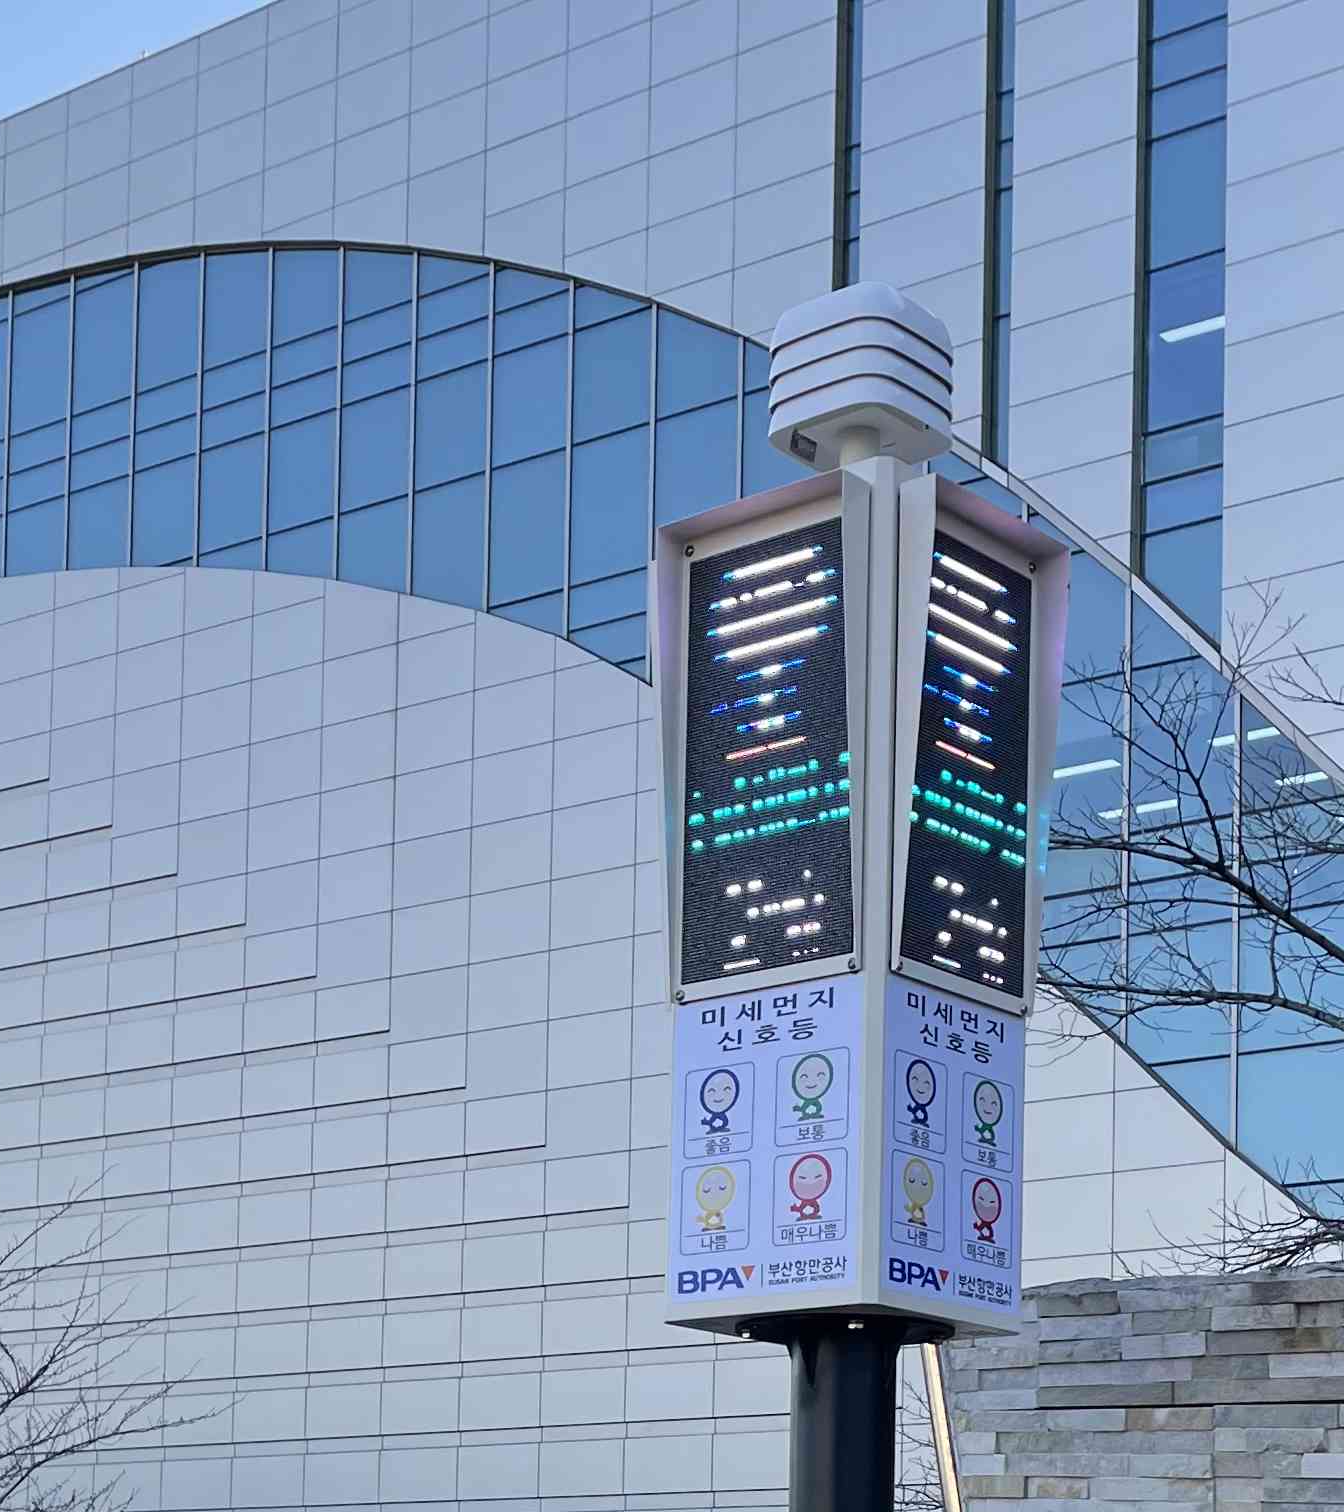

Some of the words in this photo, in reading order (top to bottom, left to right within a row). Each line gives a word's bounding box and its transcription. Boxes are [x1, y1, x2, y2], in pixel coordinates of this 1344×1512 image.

[701, 987, 834, 1027] 미세먼지
[907, 992, 1004, 1043] 미세먼지
[718, 1017, 817, 1051] 신호등
[920, 1024, 992, 1064] 신호등
[781, 1223, 837, 1243] 매우나쁨
[677, 1267, 744, 1294] BPA
[768, 1256, 848, 1277] 부산항만공사
[888, 1257, 941, 1292] BPA
